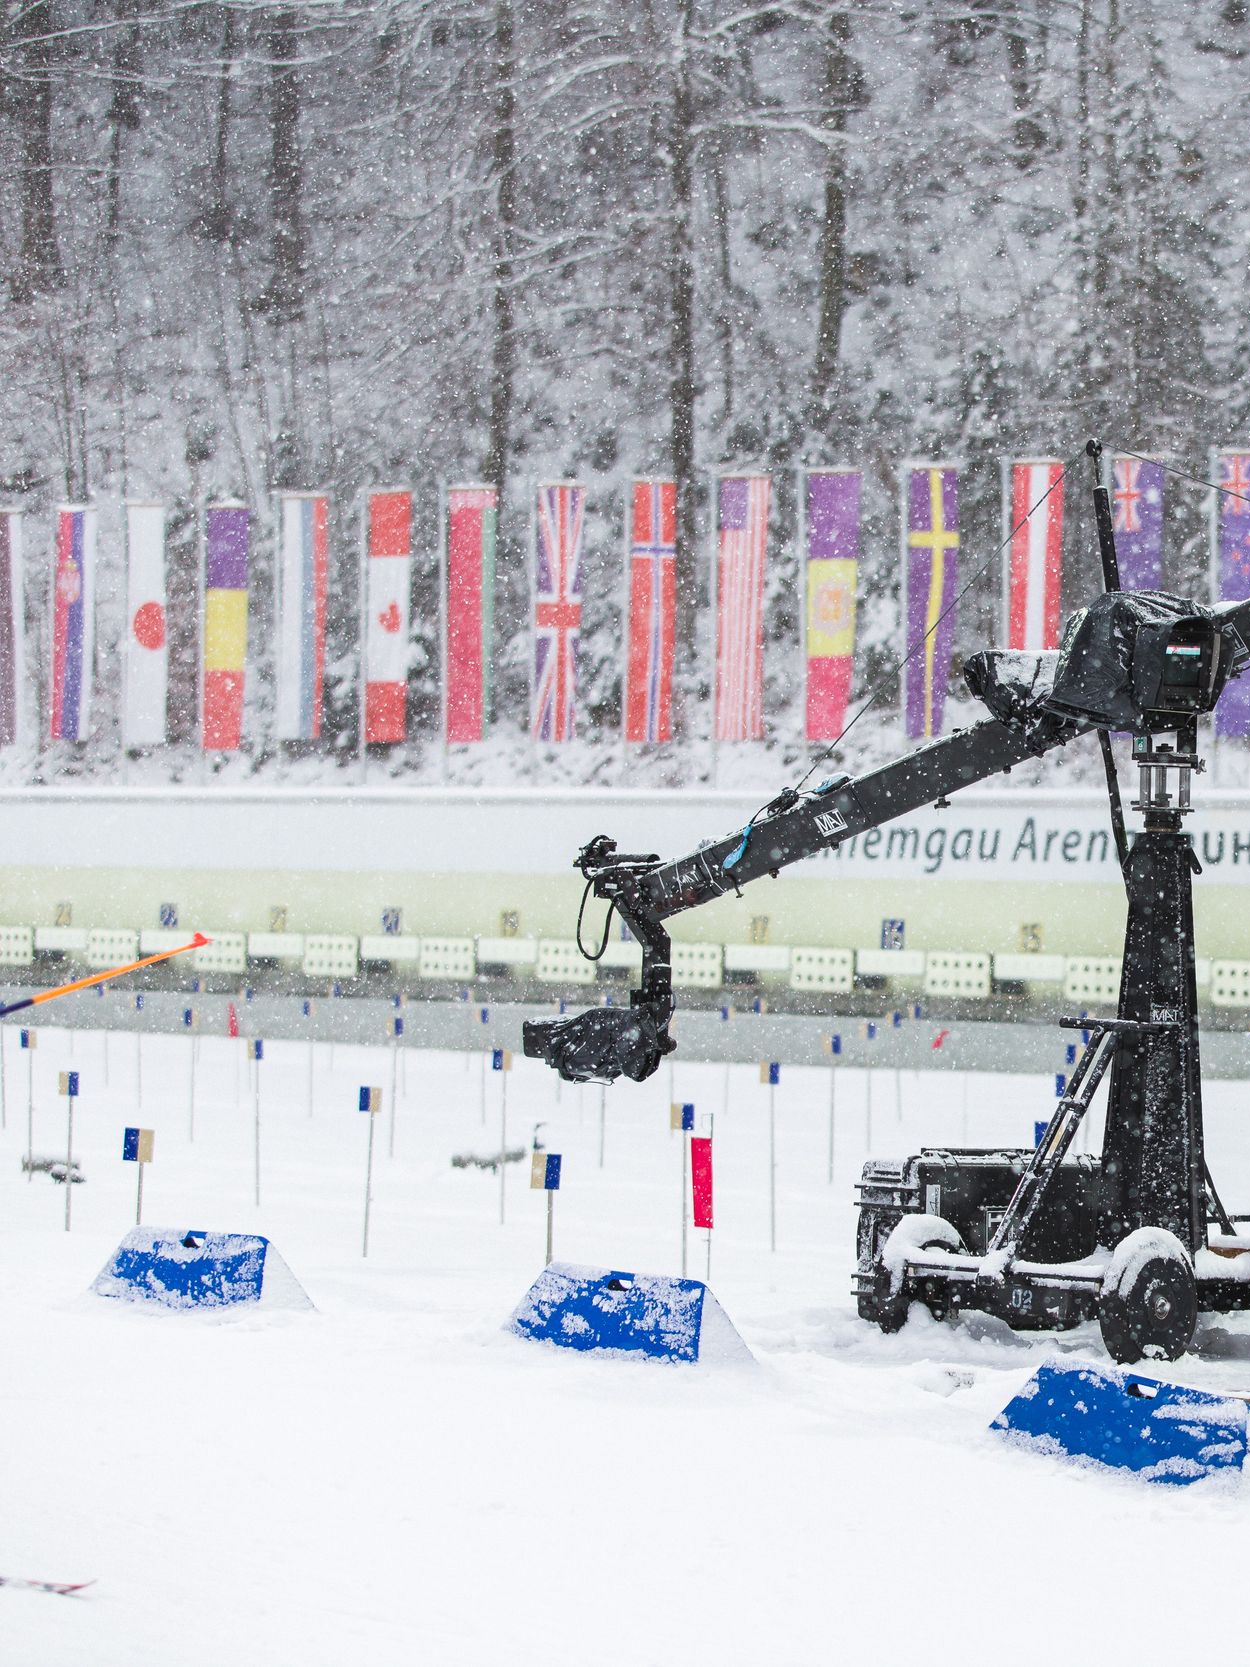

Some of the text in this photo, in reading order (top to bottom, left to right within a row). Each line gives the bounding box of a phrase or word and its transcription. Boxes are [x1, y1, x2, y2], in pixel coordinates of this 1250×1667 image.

[814, 809, 844, 833] MAT
[807, 828, 1001, 873] iemgau
[1012, 817, 1136, 862] Aren
[1152, 1009, 1180, 1021] MAT
